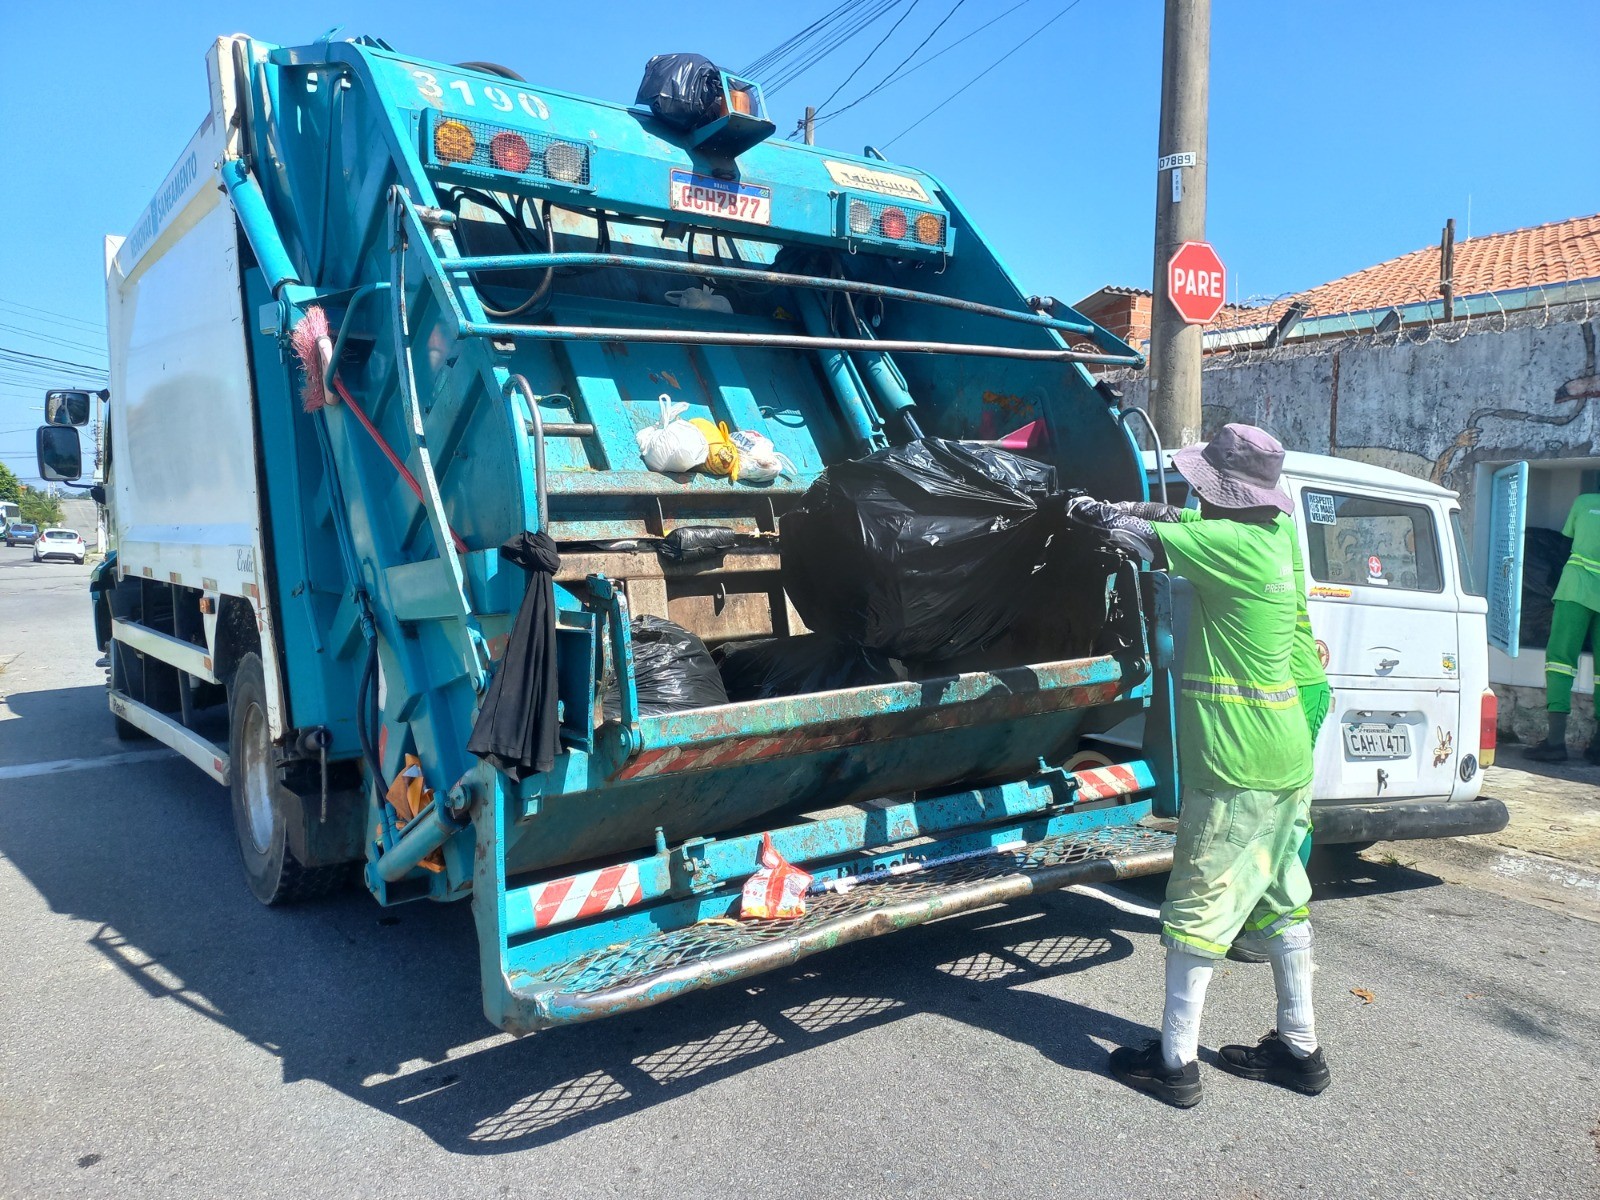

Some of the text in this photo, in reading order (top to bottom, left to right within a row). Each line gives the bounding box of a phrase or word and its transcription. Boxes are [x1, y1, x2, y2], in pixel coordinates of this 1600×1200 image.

[412, 70, 550, 120] 3190
[157, 151, 197, 223] SANEAMENTO
[713, 182, 730, 190] BRASIL
[681, 185, 761, 218] GCH7B77
[1174, 267, 1222, 298] PARE
[1309, 494, 1333, 505] RESPEITE
[1320, 504, 1334, 515] MAIS
[1311, 512, 1335, 523] VELHOS!
